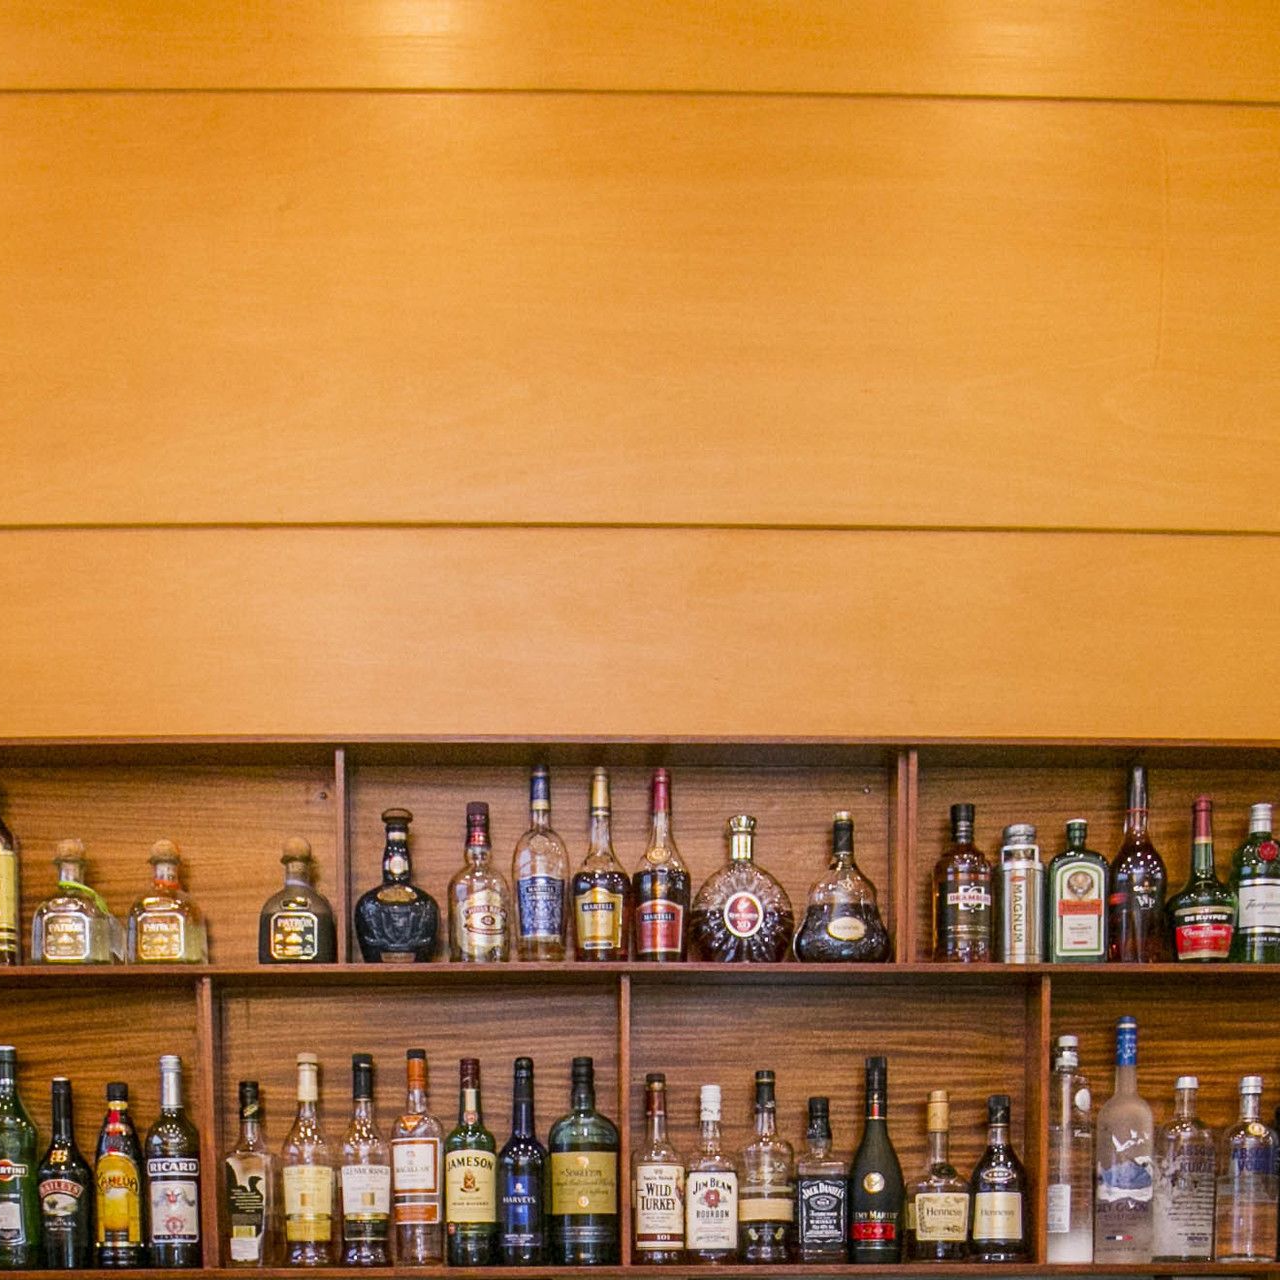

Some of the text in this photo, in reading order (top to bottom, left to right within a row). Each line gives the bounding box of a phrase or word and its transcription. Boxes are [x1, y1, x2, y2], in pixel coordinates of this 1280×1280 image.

[1013, 883, 1023, 943] MAGNUM
[149, 1162, 196, 1173] RICARD
[447, 1156, 493, 1171] JAMESON
[646, 1183, 672, 1196] WILD
[692, 1177, 732, 1195] JIM BEAM
[640, 1195, 676, 1211] TURKEY
[696, 1210, 730, 1218] BOURBON
